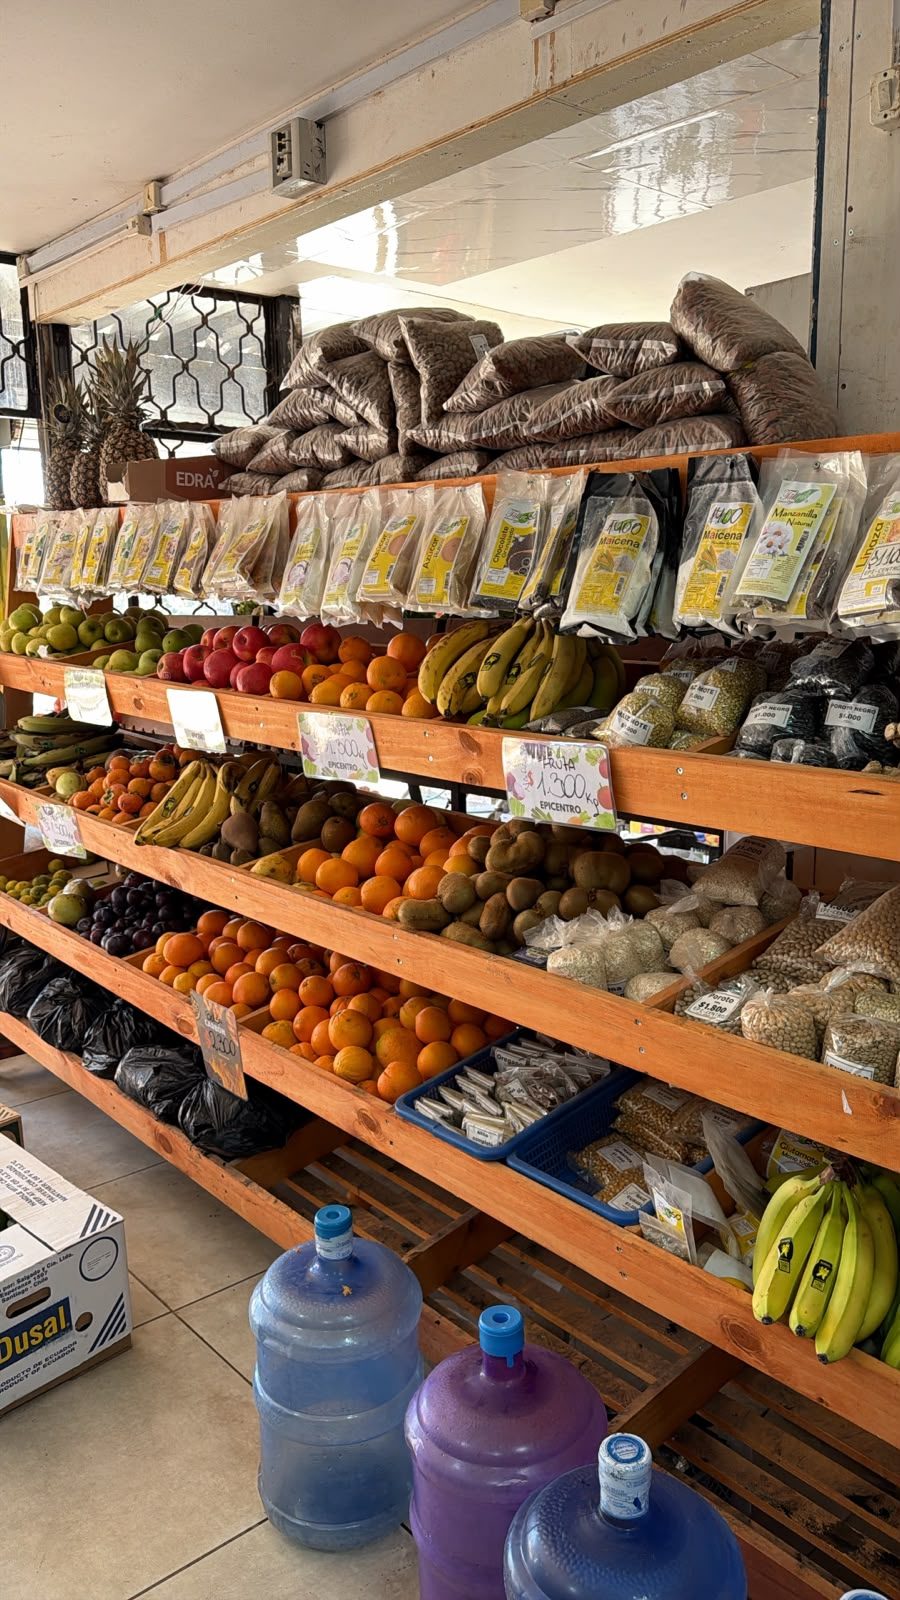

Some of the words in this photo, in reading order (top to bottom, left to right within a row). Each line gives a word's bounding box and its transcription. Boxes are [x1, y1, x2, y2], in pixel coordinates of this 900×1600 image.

[771, 508, 818, 519] Manzanilla
[786, 517, 814, 528] Natural
[598, 537, 641, 549] Maicena
[703, 531, 742, 541] Maicena
[492, 526, 508, 563] Chocolate
[855, 521, 884, 568] Linaza
[328, 761, 358, 772] EPICENTRO
[543, 755, 576, 772] FRUTA
[540, 800, 582, 814] EPICENTRO
[708, 993, 735, 1004] Poroto
[698, 1001, 728, 1014] $1.800
[780, 1142, 820, 1166] Glutamato
[26, 1179, 38, 1188] CON
[33, 1196, 48, 1206] KEEP
[16, 1269, 41, 1284] Salgado
[2, 1286, 29, 1303] Santiago
[33, 1276, 49, 1287] Chile
[0, 1305, 67, 1365] Dusal
[0, 1367, 31, 1388] ODUCTO
[33, 1361, 43, 1369] DE
[44, 1340, 78, 1363] ECUADOR
[31, 1366, 41, 1376] OF
[42, 1346, 76, 1369] ECUADOR
